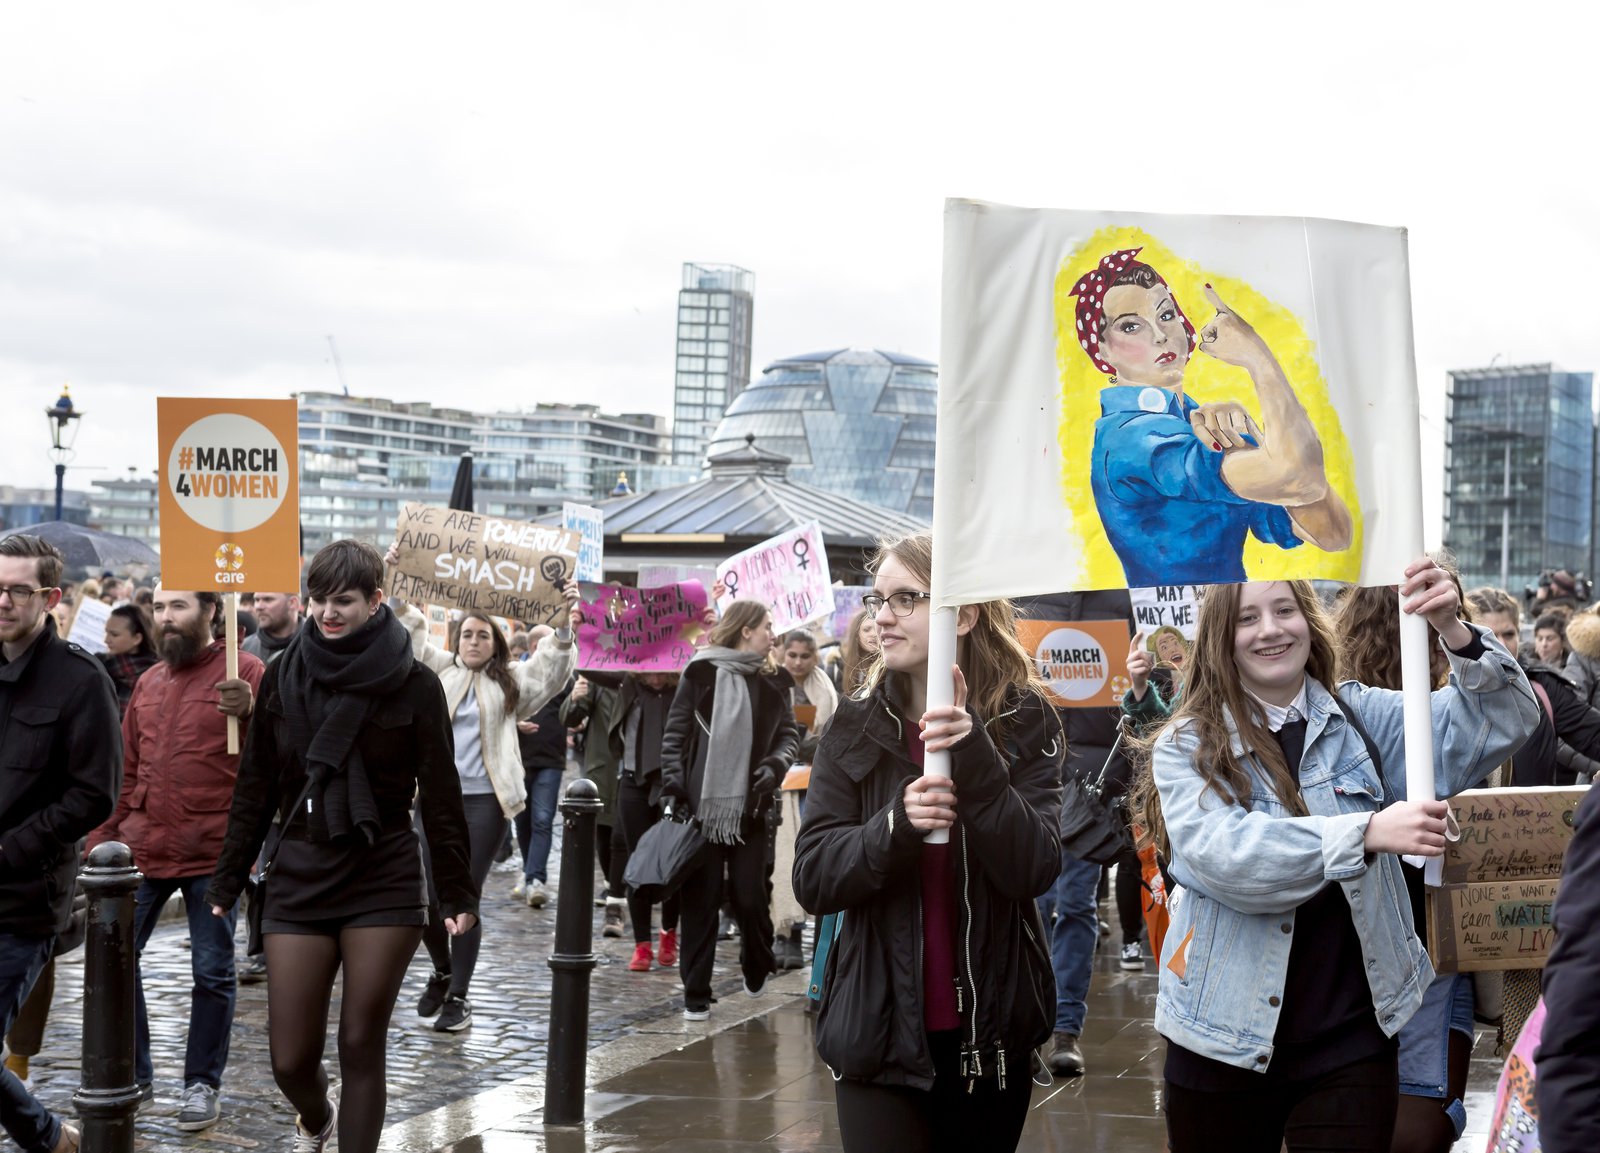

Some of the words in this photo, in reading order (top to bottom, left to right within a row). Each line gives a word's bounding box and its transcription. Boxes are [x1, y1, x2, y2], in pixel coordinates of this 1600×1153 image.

[178, 447, 278, 472] #MARCH
[176, 474, 278, 499] 4WOMEN
[405, 506, 437, 525] WE
[443, 514, 482, 533] ARE
[482, 518, 579, 558] POWERFUL
[398, 530, 441, 551] AND
[449, 536, 478, 556] WE
[485, 545, 519, 562] WILL
[215, 571, 245, 583] care
[434, 552, 536, 593] SMASH
[390, 571, 482, 610] PATRIARCHAL
[484, 591, 563, 623] SUPREMACY
[1156, 586, 1185, 602] MAY
[647, 603, 674, 625] Give
[1136, 606, 1166, 626] MAY
[1171, 605, 1193, 627] WE
[618, 630, 641, 651] Give
[1041, 648, 1101, 665] #MARCH
[1042, 665, 1103, 680] 4WOMEN
[1468, 806, 1494, 823] hate
[1512, 806, 1534, 817] hear
[1537, 811, 1553, 823] you
[1477, 848, 1504, 870] fine
[1477, 870, 1486, 880] of
[1460, 887, 1496, 909] NONE
[1520, 885, 1547, 898] WANT
[1498, 904, 1552, 926] WATE
[1464, 932, 1482, 944] ALL
[1491, 930, 1509, 942] OUR
[1518, 928, 1554, 953] LIV
